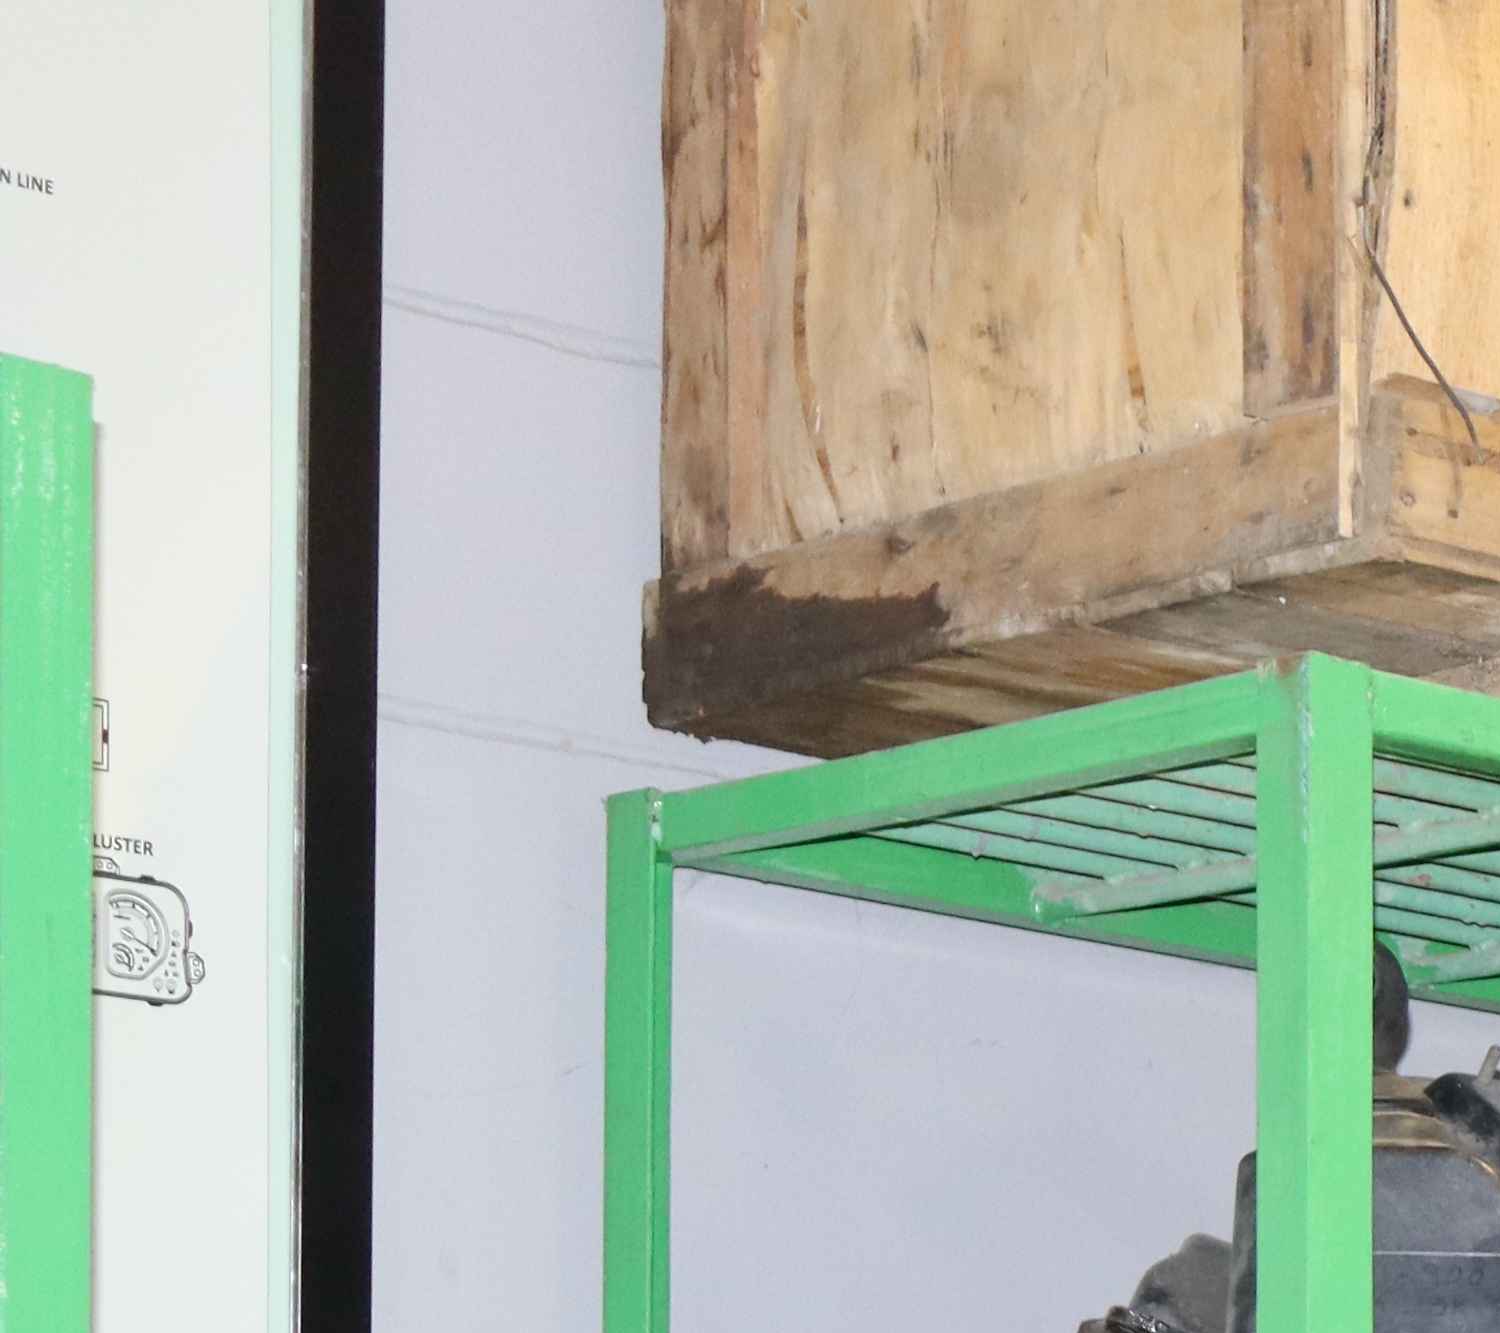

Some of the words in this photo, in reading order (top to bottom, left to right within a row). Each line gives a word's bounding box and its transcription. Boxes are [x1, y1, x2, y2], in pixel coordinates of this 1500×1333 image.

[0, 168, 11, 184] N
[17, 172, 54, 195] LINE
[93, 833, 154, 856] LUSTER
